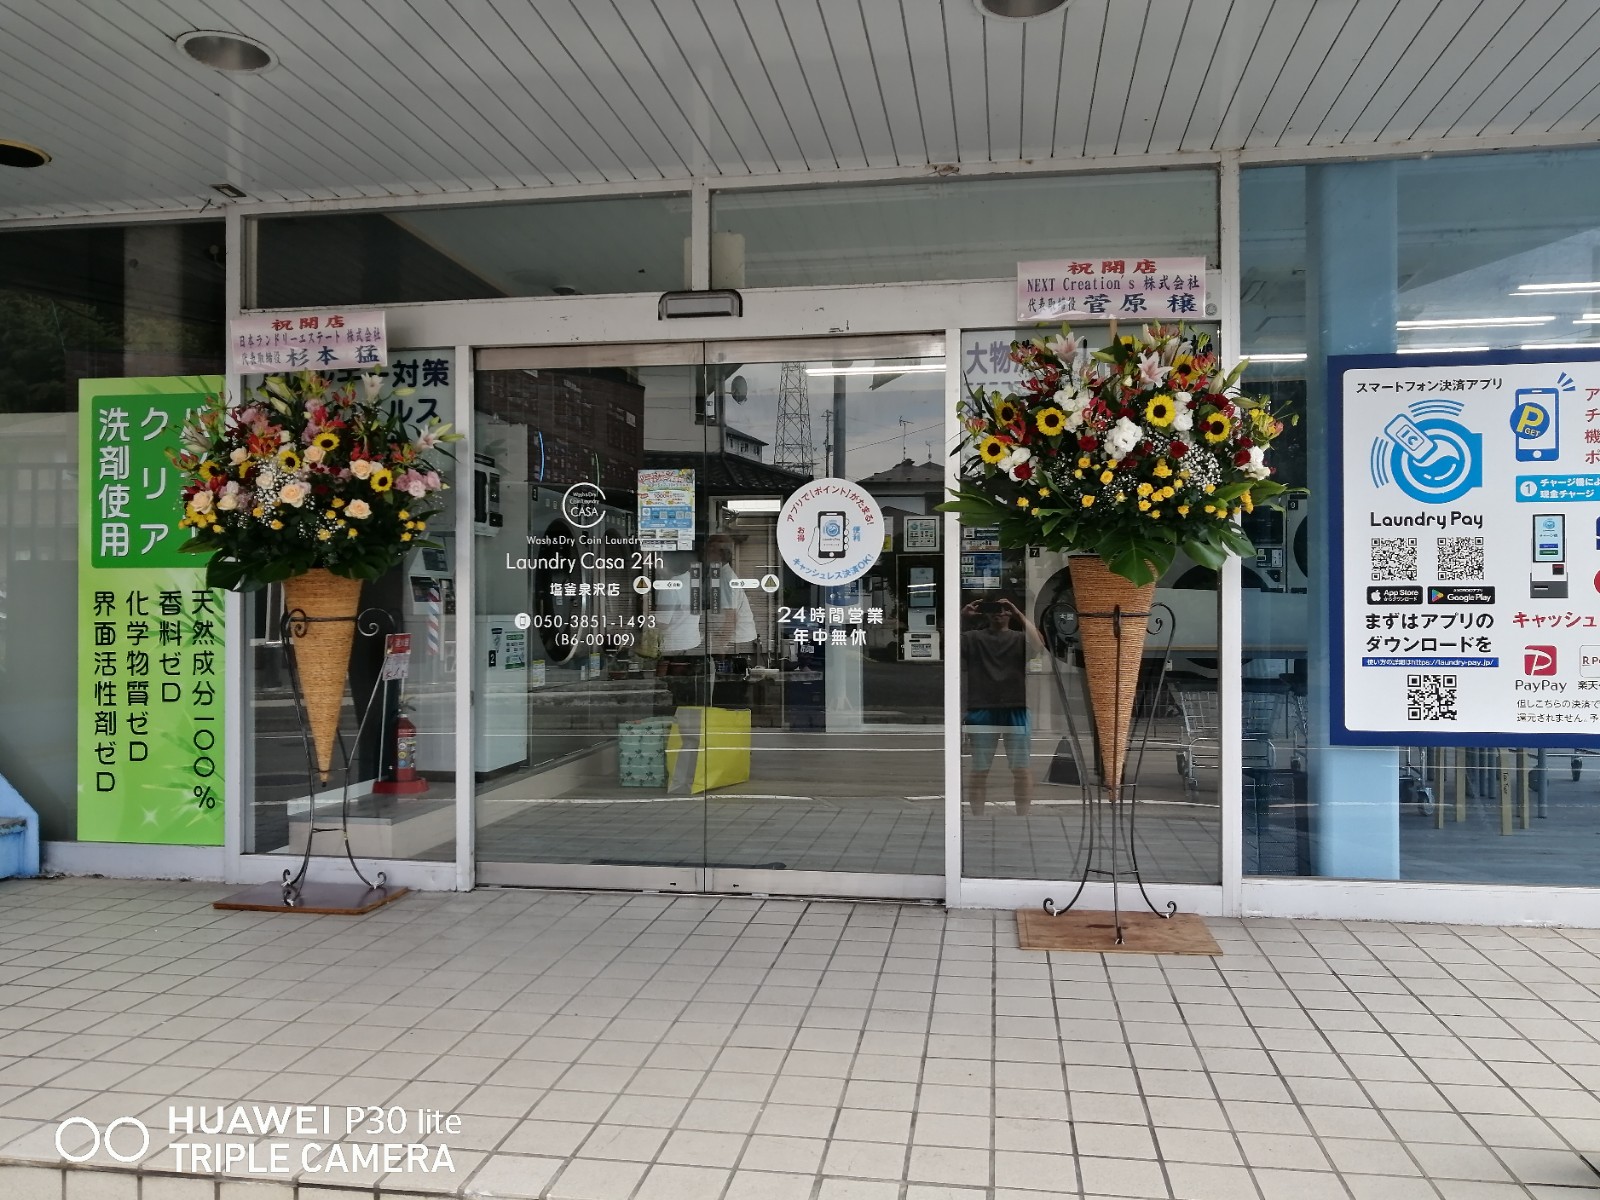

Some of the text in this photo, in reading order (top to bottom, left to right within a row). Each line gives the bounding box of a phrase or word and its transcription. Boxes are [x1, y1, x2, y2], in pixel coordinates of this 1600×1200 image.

[1067, 259, 1158, 275] 祝開店
[1027, 278, 1055, 292] NEXT
[1143, 274, 1200, 291] 株式会社
[271, 315, 345, 331] 祝開店
[239, 326, 382, 348] 日本ランドリーエステート 株式会社
[286, 346, 339, 367] 杉本
[354, 345, 380, 364] 猛
[966, 341, 1021, 376] 大物
[1356, 378, 1503, 393] スマートフォン決済アプリ
[1524, 427, 1540, 437] GET
[98, 408, 130, 557] 洗剤使用
[140, 410, 169, 555] クリア
[1540, 489, 1595, 499] 現金チャージ
[571, 507, 598, 517] CASA
[1370, 511, 1483, 529] Laundry Pay
[526, 535, 575, 547] Wash&Dry
[579, 535, 602, 545] Coin
[605, 535, 643, 546] Laundry
[852, 526, 861, 542] 便利
[506, 552, 664, 573] Laundry Casa 24h
[550, 583, 620, 597] 塩釜泉沢店
[1447, 593, 1491, 603] Google Play
[534, 615, 656, 628] 050-3851-1493
[777, 606, 883, 624] 24時間営業
[1366, 612, 1494, 629] まずはアプリの
[1512, 611, 1597, 628] キャッシュ
[159, 590, 183, 702] 香料ゼロ
[555, 633, 635, 646] (B6-00109)
[793, 629, 867, 646] 年中無休
[1366, 636, 1491, 653] ダウンロードを
[126, 590, 149, 762] 化学物質ゼロ
[94, 591, 117, 792] 界面活性剤ゼロ
[1515, 679, 1567, 693] PayPay
[1578, 680, 1600, 690] 楽天
